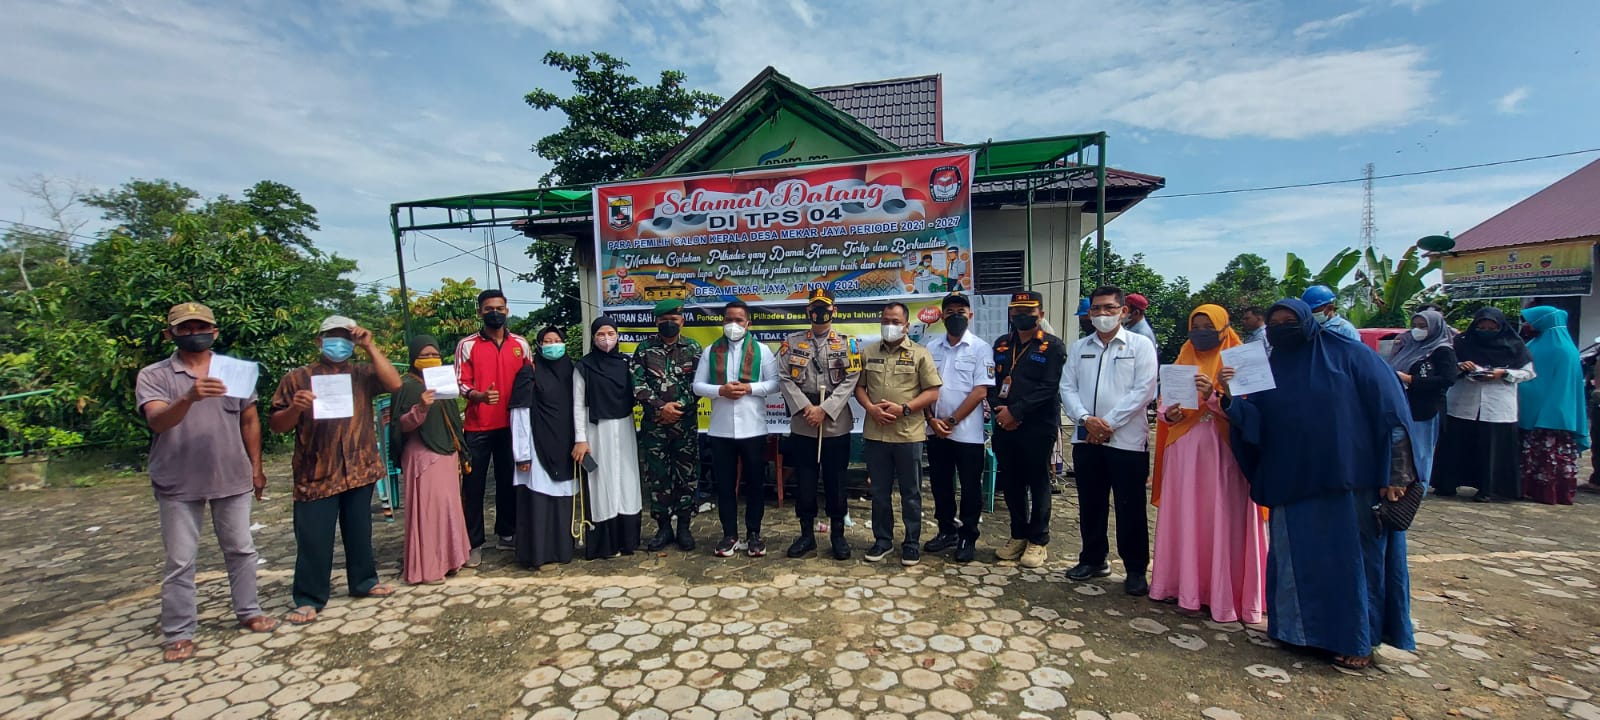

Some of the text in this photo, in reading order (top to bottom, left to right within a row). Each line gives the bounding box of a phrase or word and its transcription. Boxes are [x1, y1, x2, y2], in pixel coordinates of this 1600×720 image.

[662, 182, 885, 215] Selamat Datang
[709, 207, 842, 229] DI TPS 04
[608, 240, 632, 250] PARA
[634, 238, 671, 248] PEMILIH
[673, 236, 707, 246] CALON
[710, 233, 748, 243] KEPALA
[751, 230, 778, 241] DESA
[781, 228, 817, 239] MEKAR
[821, 226, 846, 237] JAYA
[850, 223, 897, 235] PERIODE
[900, 219, 925, 231] 2021
[935, 216, 960, 229] 2027
[707, 249, 746, 264] Pilkades
[748, 250, 766, 263] yang
[873, 241, 889, 252] dan
[891, 236, 947, 254] Berkualitas
[655, 270, 670, 280] dan
[669, 271, 695, 284] jangan
[697, 268, 713, 282] lupa
[716, 265, 749, 280] Prokes
[769, 262, 790, 279] jalan
[793, 262, 807, 273] kan
[810, 261, 838, 276] dengan
[840, 259, 858, 271] baik
[861, 258, 876, 269] dan
[623, 284, 633, 292] 17
[694, 286, 722, 296] DESA
[724, 285, 759, 295] MEKAR
[762, 284, 790, 295] JAYA,
[793, 282, 804, 292] 17
[834, 279, 859, 290] 2021
[637, 313, 653, 322] SAH
[753, 312, 807, 320] Pilkades Desa
[854, 311, 876, 319] tahun
[760, 332, 782, 340] TIDAK
